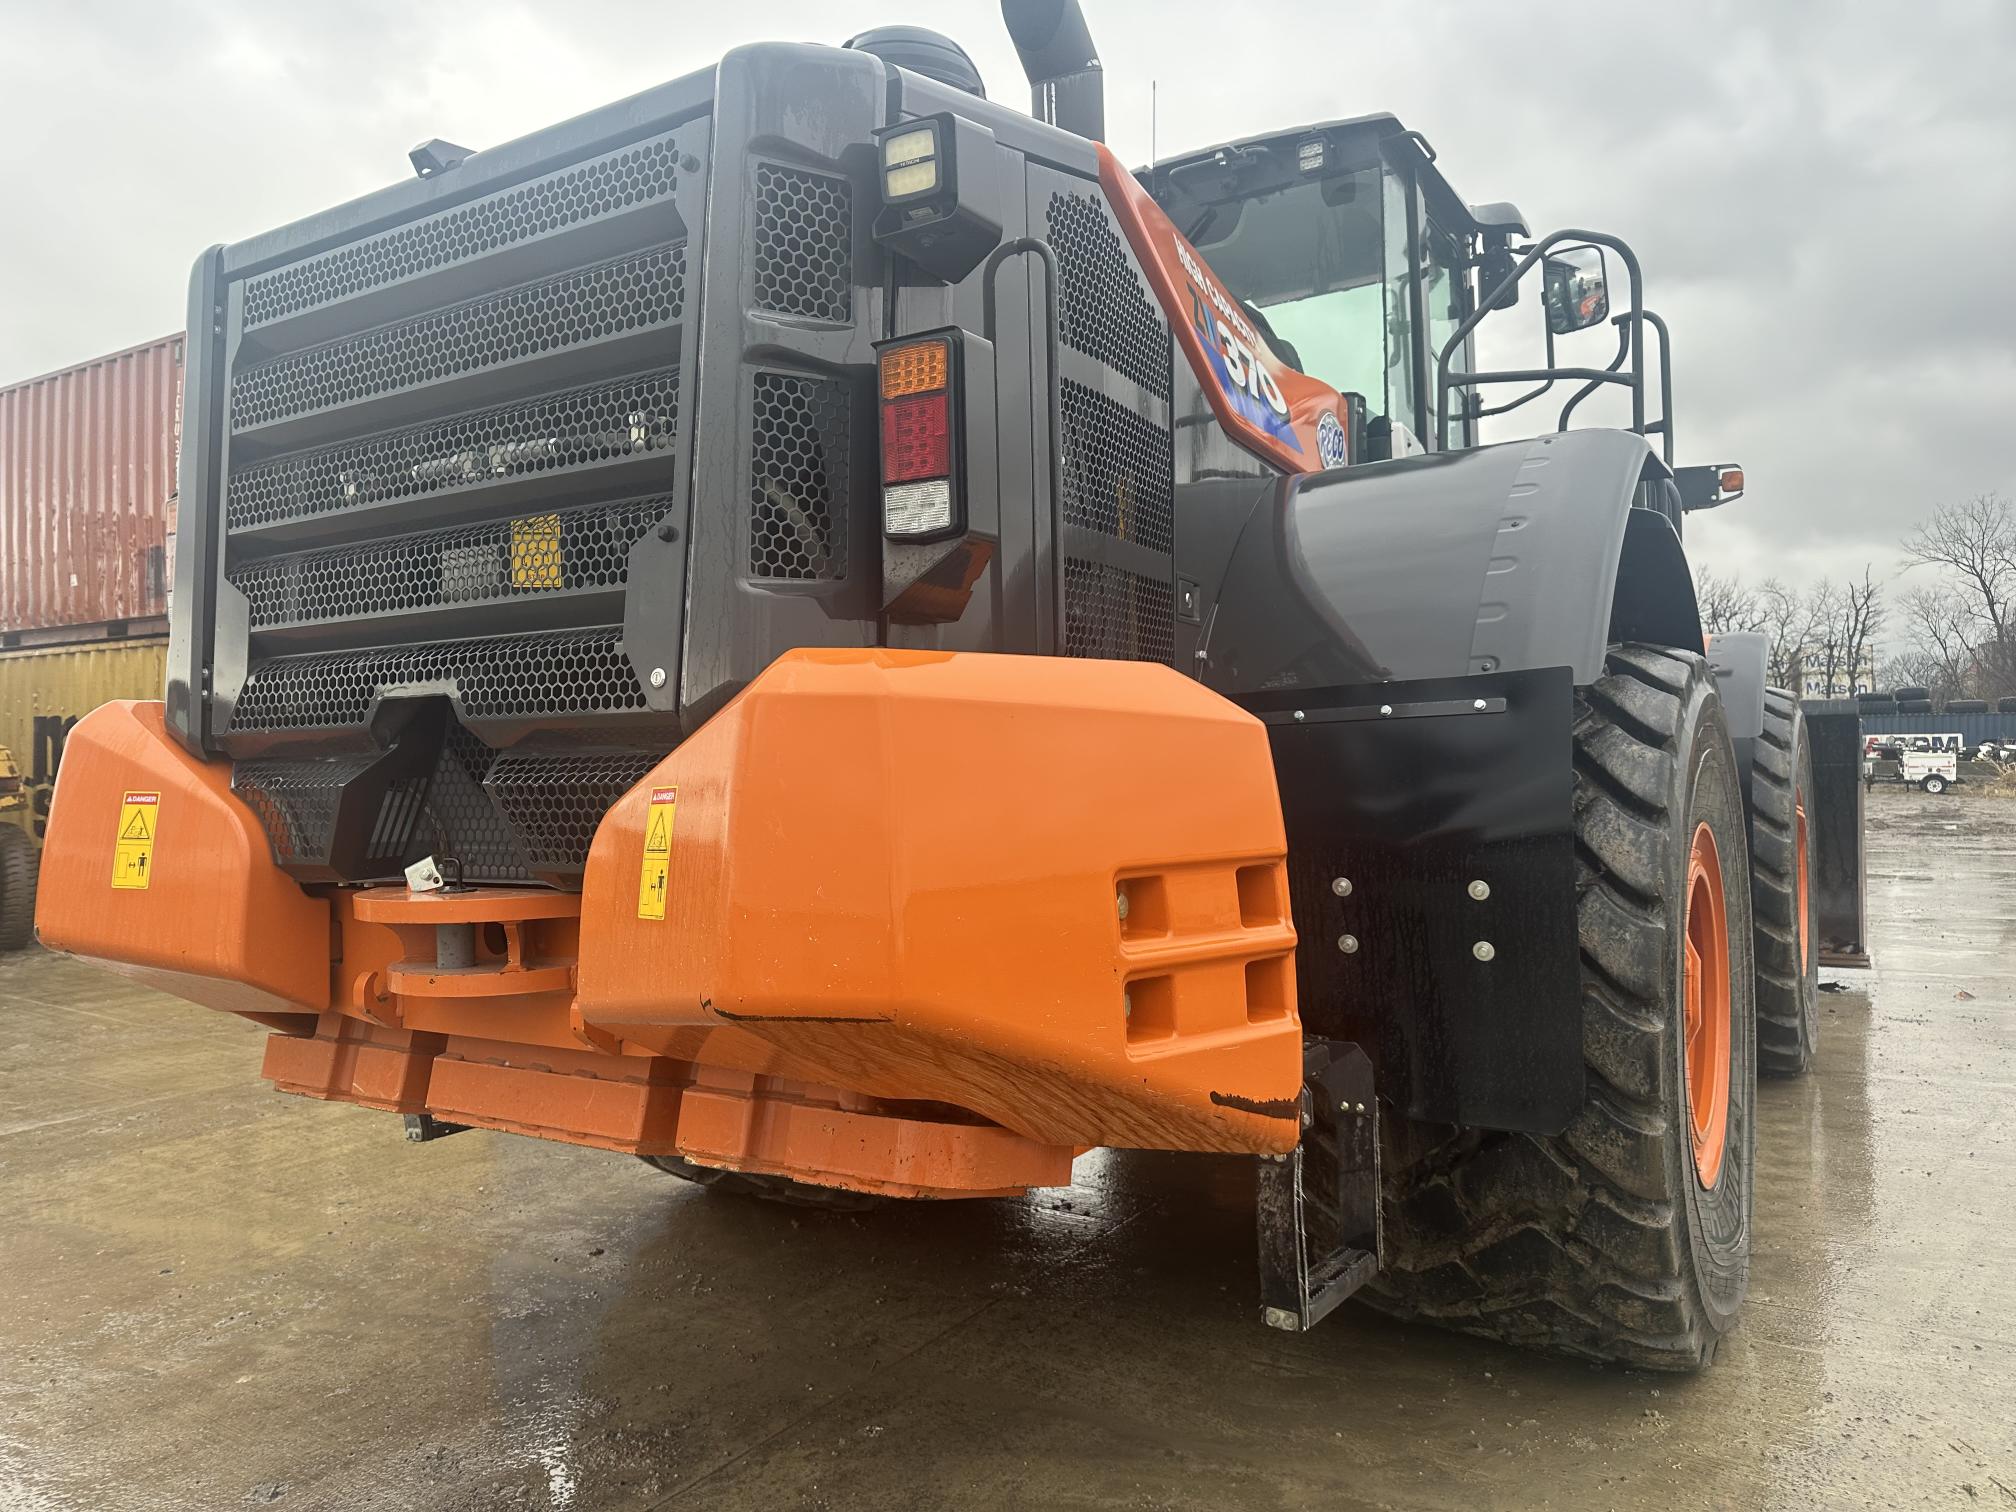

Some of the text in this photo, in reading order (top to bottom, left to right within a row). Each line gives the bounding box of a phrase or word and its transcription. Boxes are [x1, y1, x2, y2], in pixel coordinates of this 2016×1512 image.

[1172, 231, 1257, 348] HIGH CAPACITY
[1217, 319, 1288, 415] 370
[1806, 654, 1868, 668] Matsn
[133, 795, 157, 803] DANGER
[657, 792, 675, 800] DANGER
